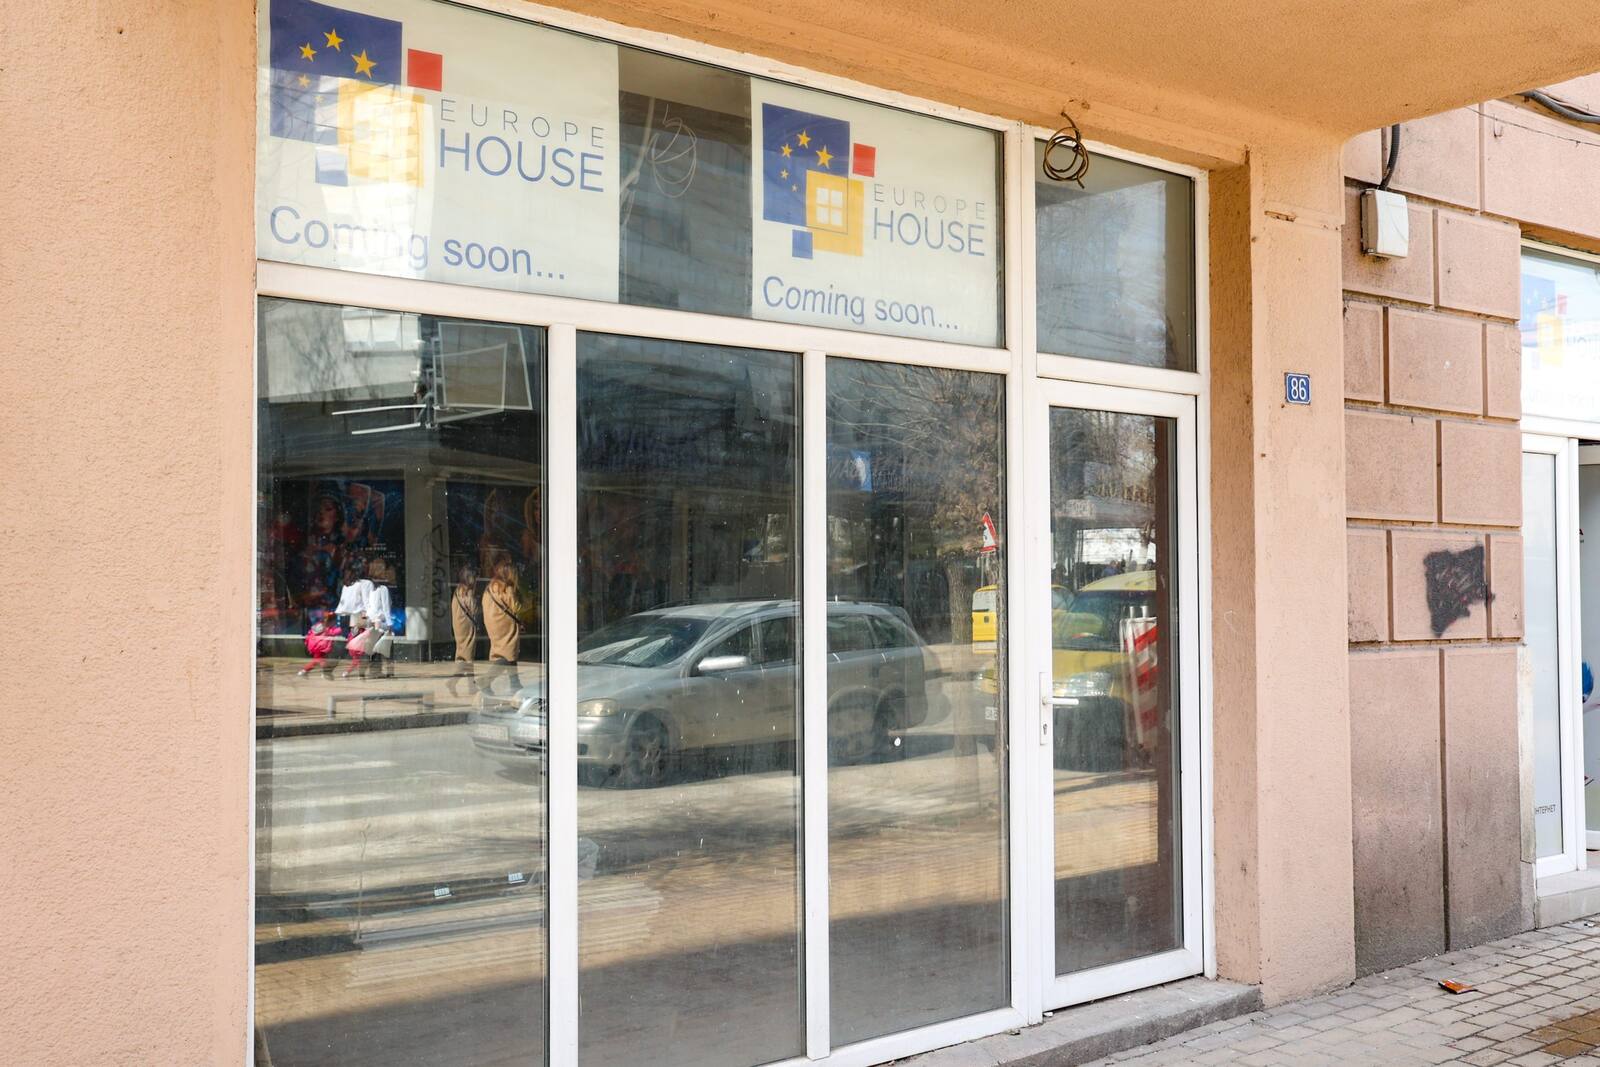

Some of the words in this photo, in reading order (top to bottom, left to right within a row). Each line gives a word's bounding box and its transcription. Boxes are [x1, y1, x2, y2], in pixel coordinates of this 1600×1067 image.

[440, 99, 605, 149] EUROPE
[439, 128, 605, 193] HOUSE
[874, 184, 985, 220] EUROPE
[873, 208, 985, 257] HOUSE
[443, 239, 566, 280] soon...
[763, 276, 865, 325] Coming
[874, 299, 959, 331] soon...
[1291, 377, 1307, 400] 86
